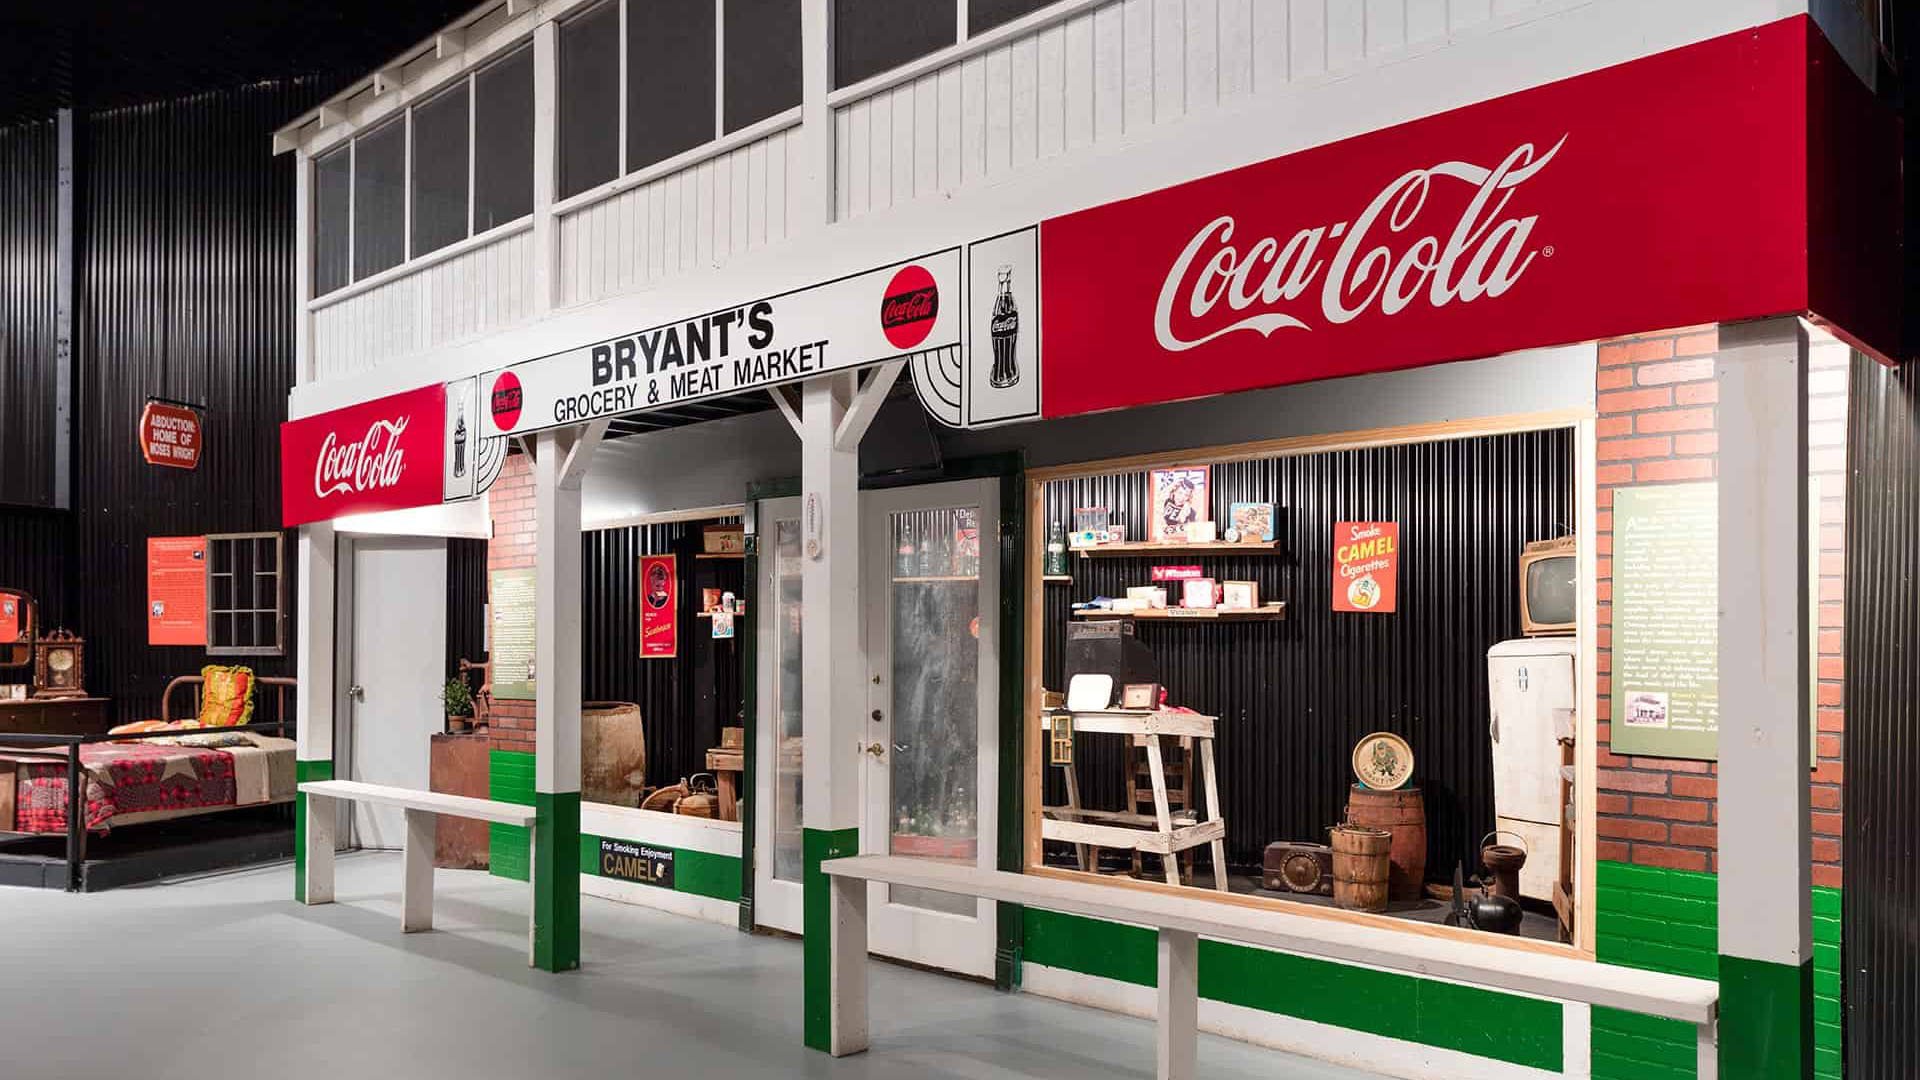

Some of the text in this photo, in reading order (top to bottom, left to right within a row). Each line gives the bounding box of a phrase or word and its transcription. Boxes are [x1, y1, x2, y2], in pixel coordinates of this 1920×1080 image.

[1154, 132, 1569, 352] Coca-Cola
[883, 289, 937, 325] Coca-Cola
[592, 301, 775, 387] BRYANT'S
[554, 383, 638, 422] GROCERY
[647, 385, 660, 404] &
[670, 364, 724, 400] MEAT
[734, 340, 829, 388] MARKET
[153, 428, 192, 446] HOME OF
[314, 414, 410, 498] Coca-Cola
[1350, 523, 1381, 541] Smoke
[1337, 536, 1394, 564] CAMEL
[1340, 559, 1390, 580] Cigarettes
[601, 840, 673, 861] For Smoking Enjoyment
[603, 853, 657, 882] CAMEL
